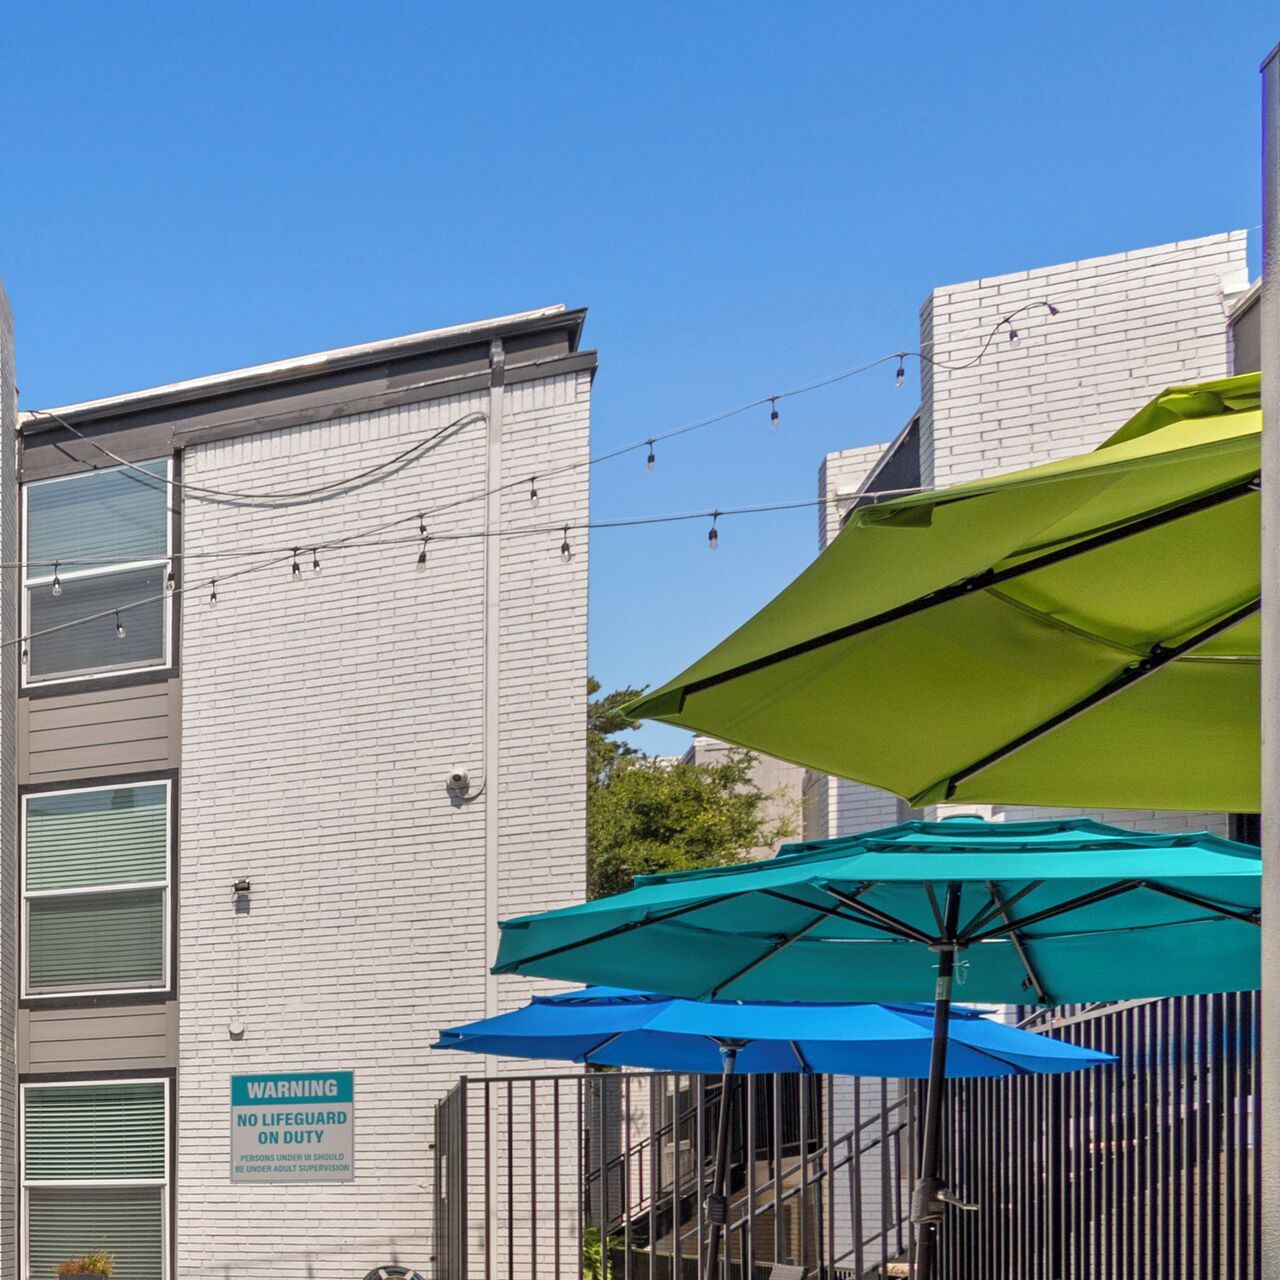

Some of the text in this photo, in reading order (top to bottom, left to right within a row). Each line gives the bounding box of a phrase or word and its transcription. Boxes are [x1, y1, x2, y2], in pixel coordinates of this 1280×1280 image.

[247, 1079, 338, 1098] WARNING
[237, 1111, 347, 1127] NO LIFEGUARD
[258, 1130, 324, 1145] ON DUTY
[240, 1153, 344, 1162] PERSONS UNDER 18 SHOULD
[235, 1164, 349, 1173] BE UNDER ADULT SUPERVISION
